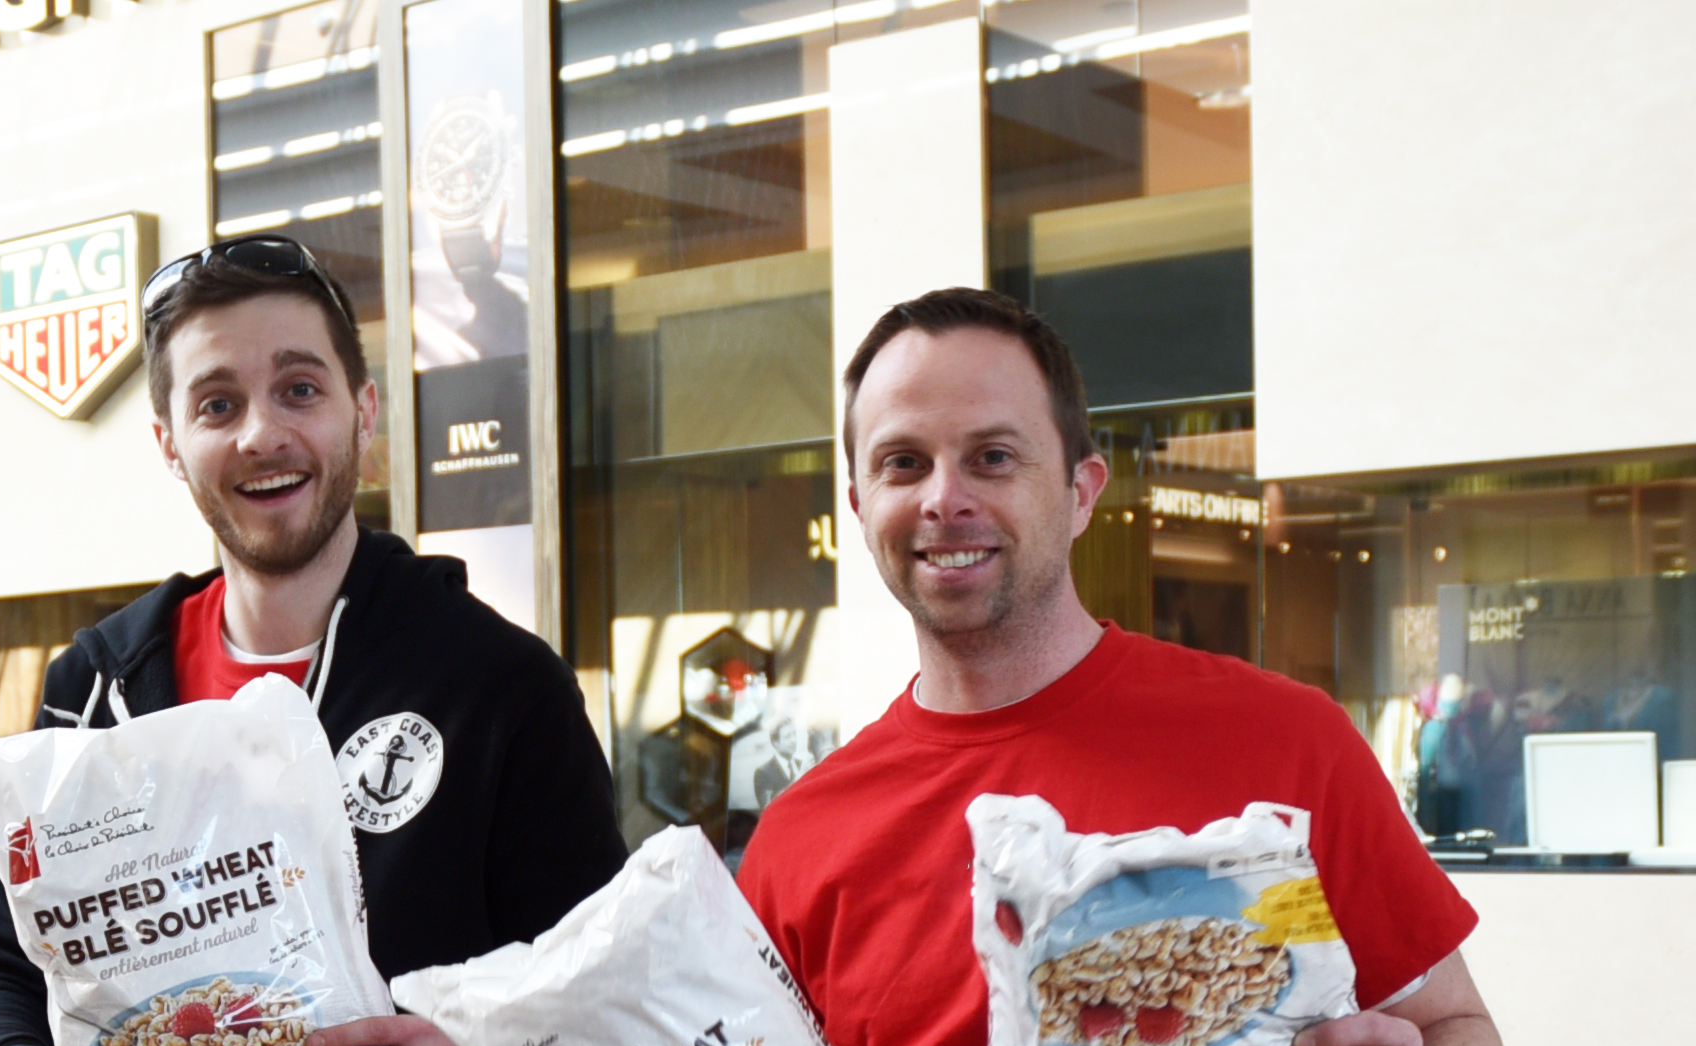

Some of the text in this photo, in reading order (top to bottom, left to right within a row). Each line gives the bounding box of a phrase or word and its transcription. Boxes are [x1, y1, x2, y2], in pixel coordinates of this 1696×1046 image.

[1, 230, 121, 307] TAG
[0, 300, 126, 400] HEUER
[447, 420, 501, 456] IWC
[431, 452, 521, 476] SCHAFFHAUSEN
[1469, 606, 1524, 624] MONT
[1469, 623, 1524, 643] BLANC
[345, 718, 439, 764] EAST COAST
[105, 837, 209, 883] All Natural
[34, 840, 277, 936] PUFFED WHEAT
[62, 872, 278, 967] BLÉ SOUFFLÉ
[99, 936, 202, 981] entièrement
[203, 916, 260, 952] naturel
